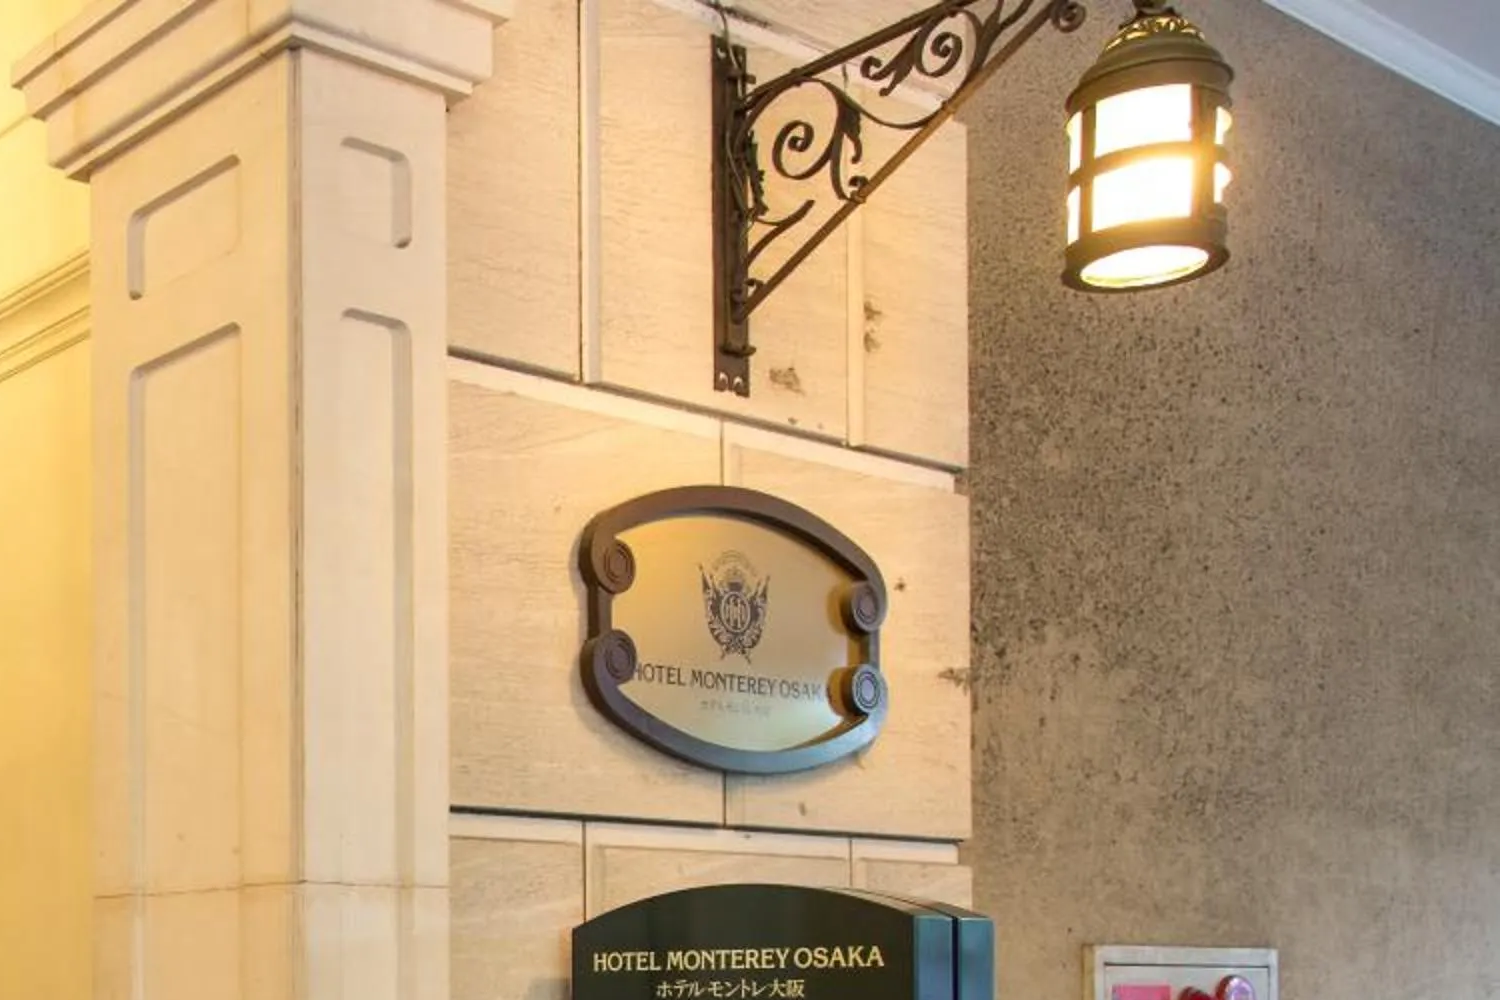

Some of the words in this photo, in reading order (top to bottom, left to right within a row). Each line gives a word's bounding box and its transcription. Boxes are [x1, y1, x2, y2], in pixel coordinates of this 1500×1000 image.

[634, 663, 686, 686] HOTEL
[691, 669, 778, 697] MONTEREY
[779, 680, 824, 700] OSAK
[592, 951, 661, 972] HOTEL
[666, 949, 790, 970] MONTEREY
[793, 945, 885, 969] OSAKA
[656, 978, 805, 999] ホテルモントレ大阪
